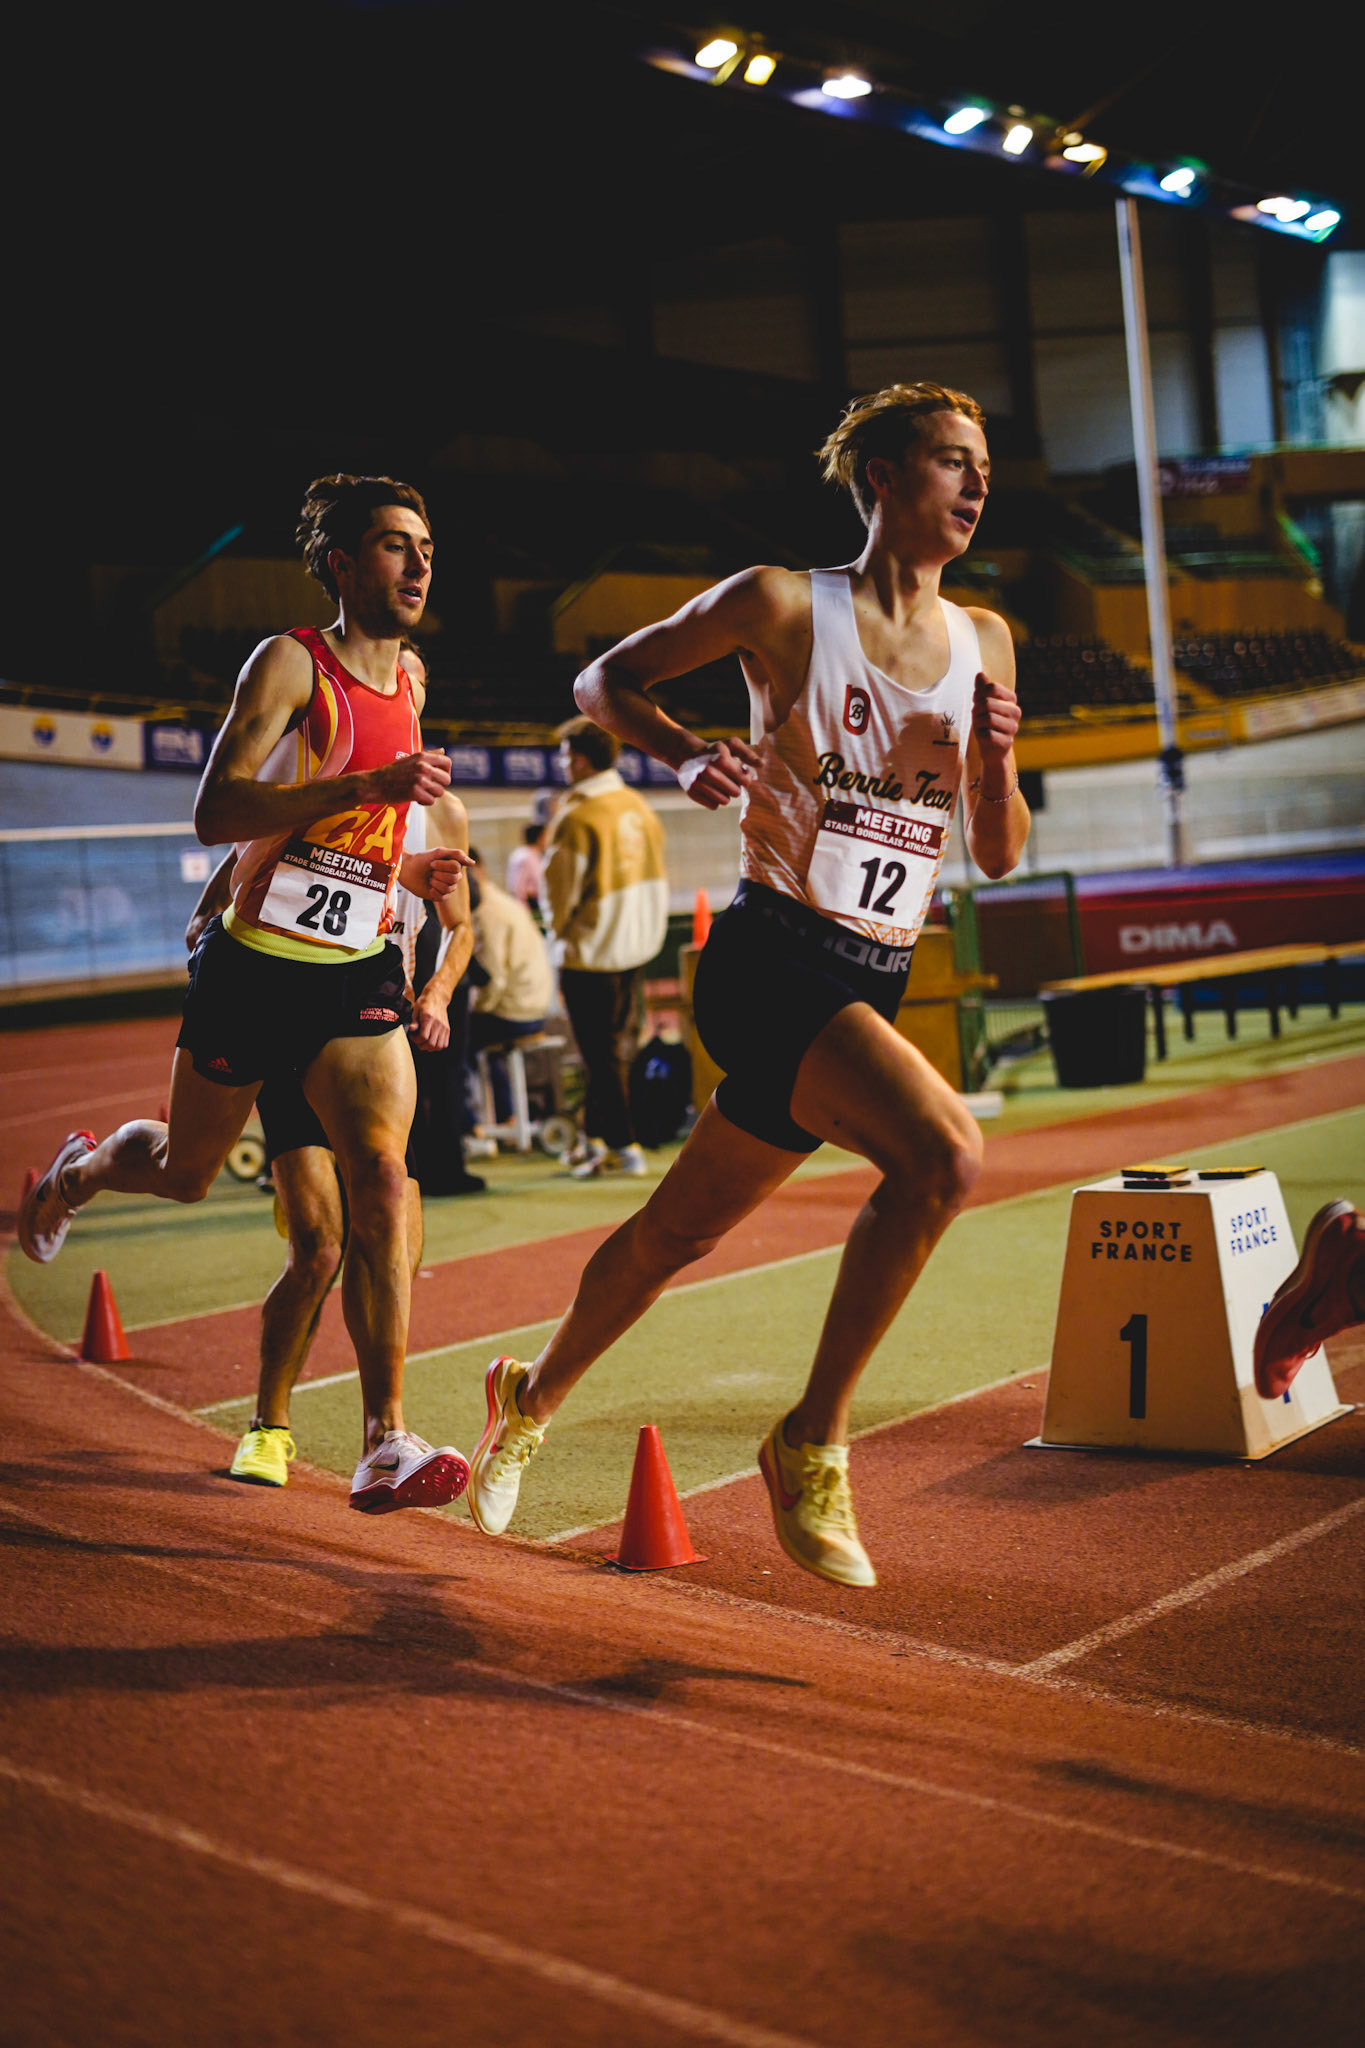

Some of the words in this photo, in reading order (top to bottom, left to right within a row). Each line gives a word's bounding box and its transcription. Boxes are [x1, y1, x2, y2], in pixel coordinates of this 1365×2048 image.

[813, 752, 903, 801] Bernie
[825, 819, 855, 834] STADE
[856, 827, 904, 847] BORDELAIS
[855, 808, 932, 843] MEETING
[284, 854, 308, 867] STADE
[309, 860, 346, 878] BORDELAIS
[347, 873, 387, 891] ATHLÉTISME
[310, 847, 373, 876] MEETING
[858, 857, 906, 916] 12
[296, 884, 351, 936] 28
[1119, 920, 1237, 953] DIMA
[1100, 1221, 1182, 1239] SPORT
[1231, 1207, 1268, 1233] SPORT
[1092, 1242, 1192, 1262] FRANCE
[1231, 1225, 1278, 1256] FRANCE
[1120, 1314, 1148, 1419] 1
